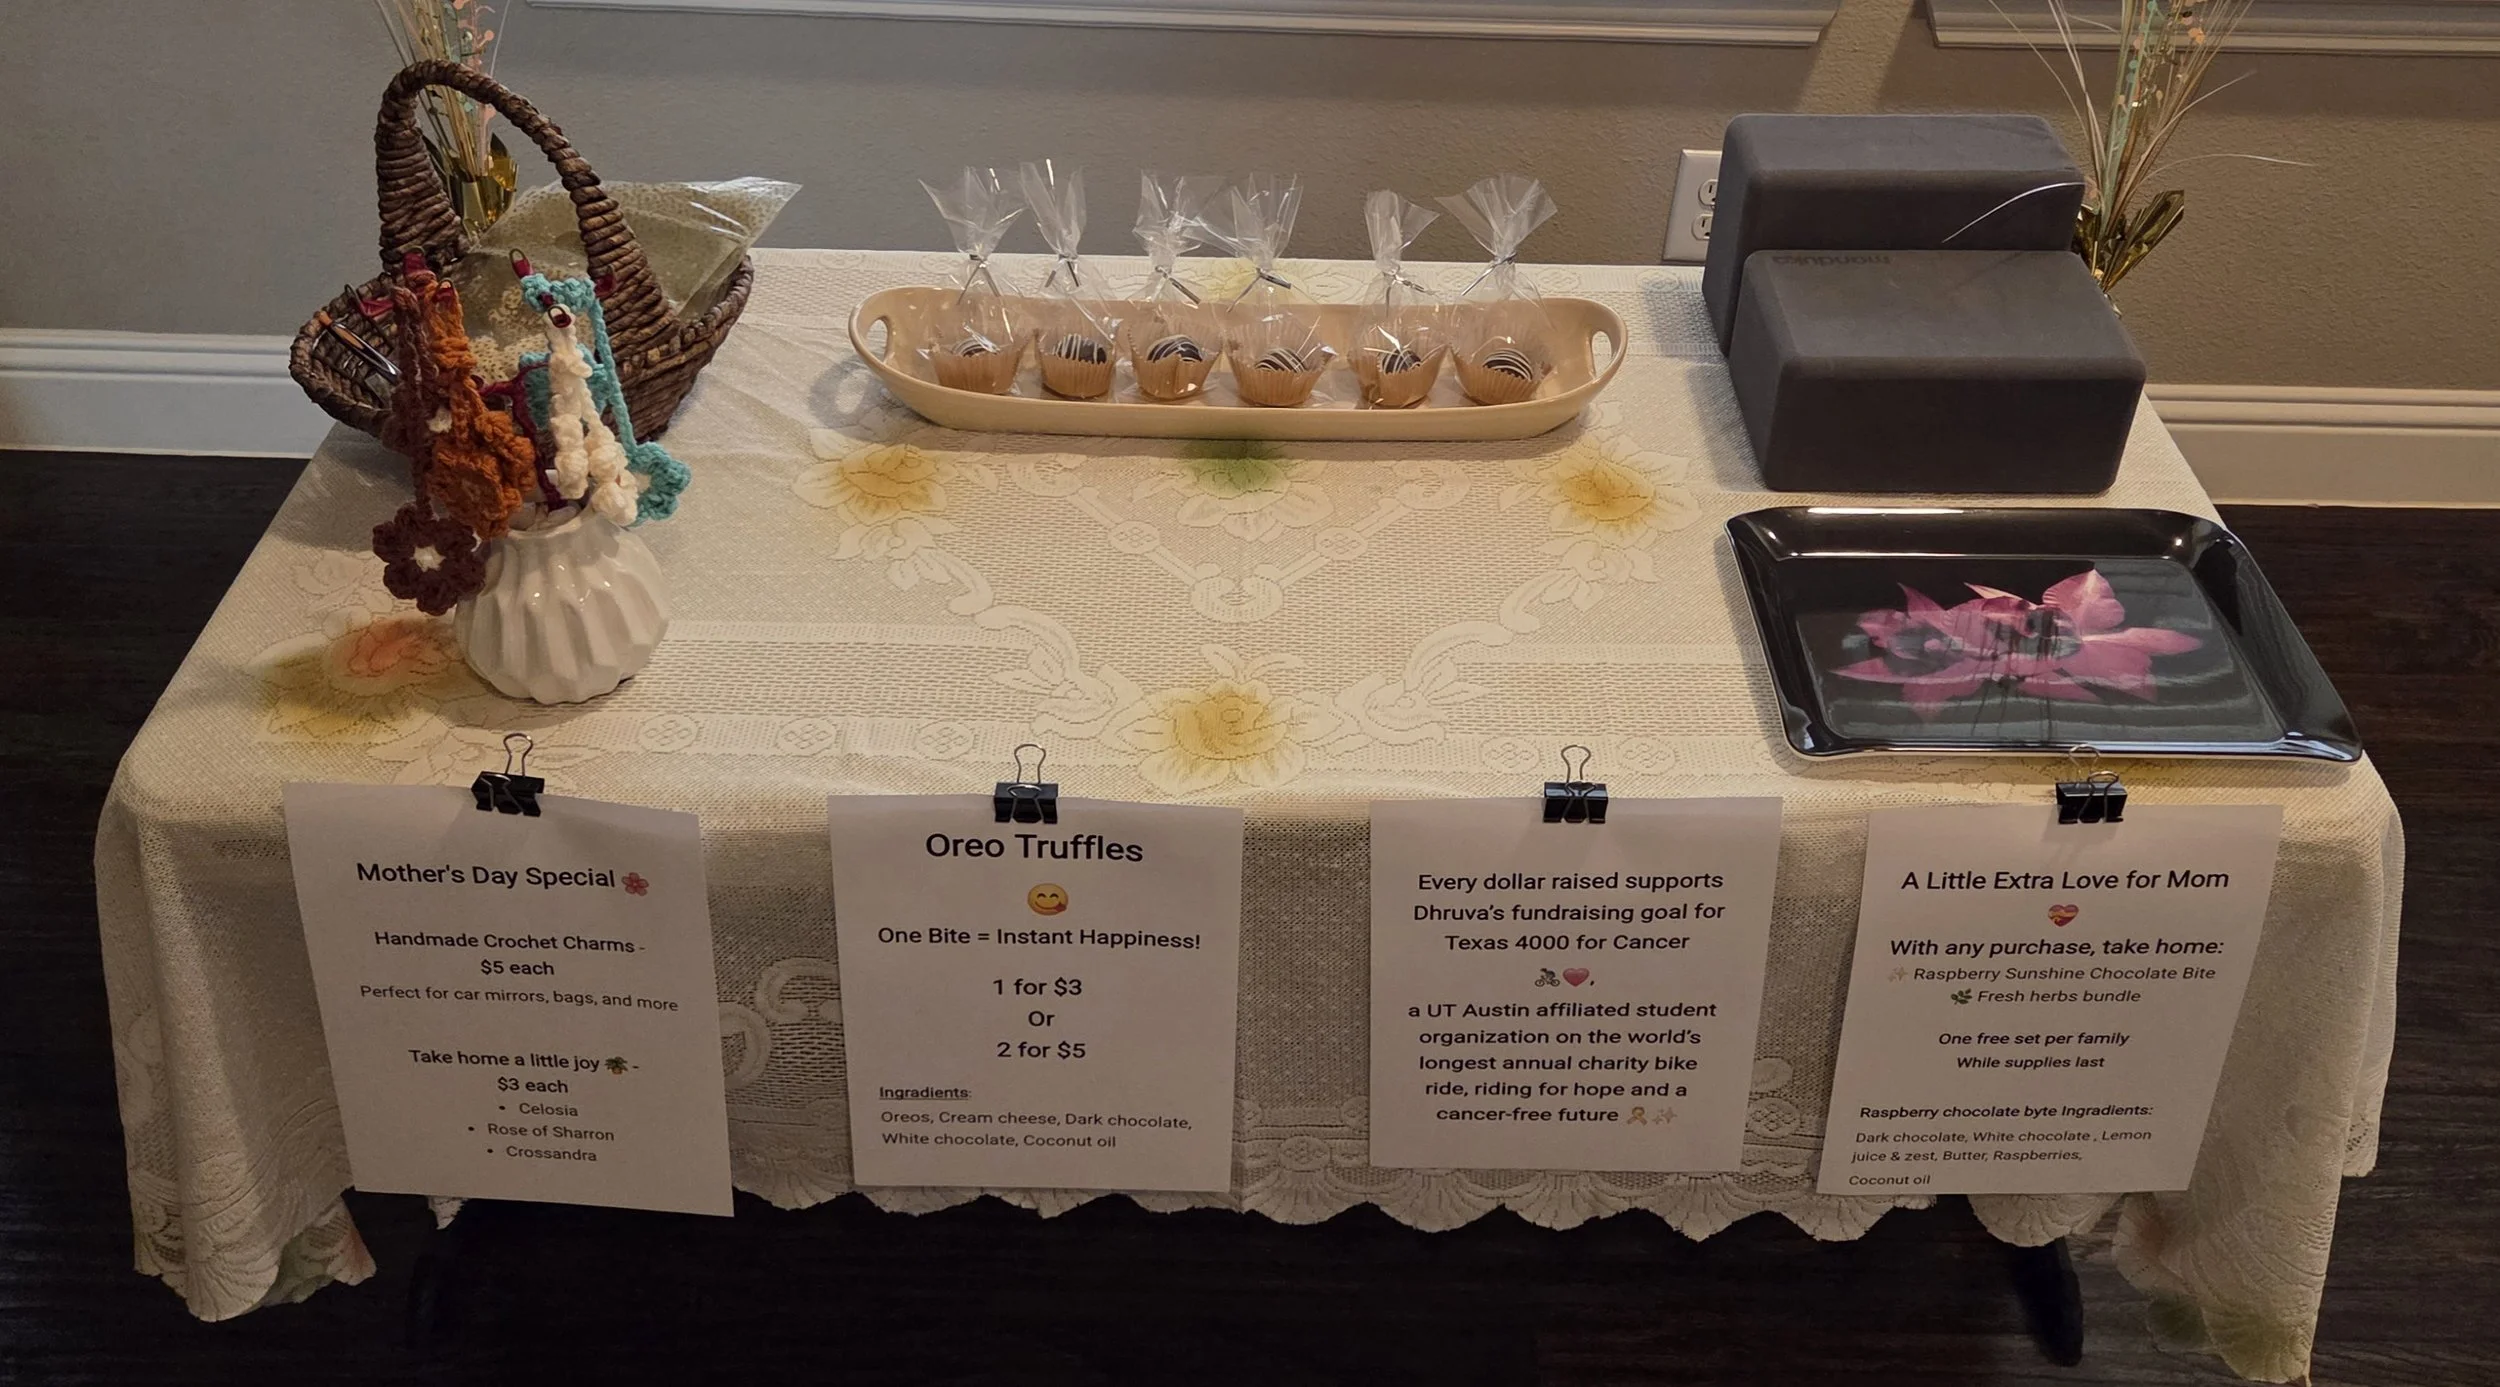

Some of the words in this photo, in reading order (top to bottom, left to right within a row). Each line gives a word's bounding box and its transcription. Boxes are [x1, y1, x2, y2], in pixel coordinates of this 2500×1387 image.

[1771, 255, 1890, 268] manduka
[926, 834, 1004, 857] Oreo
[1015, 834, 1143, 862] Truffles
[357, 863, 465, 883] Mother's
[472, 866, 518, 889] Day
[526, 867, 615, 889] Special
[1419, 875, 1477, 893] Every
[1484, 873, 1546, 889] dollar
[1552, 872, 1618, 889] raised
[1626, 874, 1723, 892] supports
[1901, 872, 1919, 889] A
[1927, 871, 1986, 889] Little
[1994, 872, 2053, 889] Extra
[2062, 872, 2118, 889] Love
[2126, 870, 2161, 888] for
[2167, 870, 2229, 888] Mom
[1512, 904, 1634, 923] fundraising
[1641, 904, 1687, 923] goal
[1695, 903, 1725, 918] for
[375, 932, 478, 947] Handmade
[484, 934, 558, 949] Crochet
[563, 936, 635, 953] Charms
[878, 928, 921, 943] One
[929, 928, 970, 943] Bite
[998, 929, 1072, 944] Instant
[1080, 929, 1199, 949] Happiness!
[1445, 936, 1508, 950] Texas
[1515, 935, 1569, 950] 4000
[1577, 935, 1607, 949] for
[1614, 935, 1690, 949] Cancer
[1891, 940, 1938, 955] With
[1945, 943, 1984, 958] any
[1989, 939, 2095, 958] purchase,
[2103, 939, 2149, 954] take
[2156, 939, 2224, 954] home:
[481, 959, 504, 975] $5
[510, 961, 554, 975] each
[1914, 968, 2000, 982] Raspberry
[2005, 968, 2084, 979] Sunshine
[2090, 968, 2177, 979] Chocolate
[2183, 967, 2215, 979] Bite
[993, 979, 1002, 995] 1
[1014, 978, 1047, 995] for
[1054, 977, 1082, 997] $3
[361, 986, 421, 999] Perfect
[426, 987, 448, 999] for
[454, 991, 480, 1000] car
[485, 990, 549, 1003] mirrors,
[553, 991, 597, 1006] bags,
[602, 995, 632, 1006] and
[637, 999, 678, 1011] more
[1978, 990, 2024, 1002] Fresh
[2030, 990, 2078, 1002] herbs
[2083, 990, 2141, 1001] bundle
[1408, 1007, 1420, 1017] a
[1428, 1004, 1456, 1017] UT
[1463, 1004, 1529, 1017] Austin
[1536, 1003, 1630, 1016] affiliated
[1637, 1003, 1717, 1016] student
[1029, 1011, 1055, 1026] Or
[1420, 1030, 1549, 1046] organization
[1556, 1033, 1581, 1043] on
[1588, 1029, 1621, 1043] the
[1939, 1034, 1972, 1044] One
[1978, 1033, 2010, 1044] free
[2014, 1034, 2040, 1044] set
[2045, 1035, 2074, 1046] per
[2078, 1032, 2130, 1046] family
[997, 1042, 1011, 1057] 2
[1018, 1042, 1051, 1058] for
[1058, 1041, 1085, 1059] $5
[408, 1050, 452, 1064] Take
[457, 1051, 509, 1065] home
[515, 1056, 525, 1066] a
[531, 1053, 569, 1068] little
[574, 1056, 599, 1072] joy
[1420, 1056, 1496, 1072] longest
[1503, 1056, 1571, 1069] annual
[1578, 1056, 1649, 1073] charity
[1655, 1056, 1697, 1070] bike
[1958, 1057, 2000, 1068] While
[2005, 1057, 2071, 1070] supplies
[2075, 1057, 2104, 1067] last
[498, 1077, 519, 1091] $3
[526, 1080, 568, 1093] each
[1426, 1082, 1468, 1097] ride,
[1475, 1082, 1531, 1099] riding
[1539, 1082, 1568, 1096] for
[1574, 1082, 1624, 1099] hope
[1631, 1083, 1669, 1096] and
[1675, 1086, 1687, 1096] a
[519, 1103, 578, 1116] Celosia
[1437, 1107, 1552, 1121] cancer-free
[1558, 1108, 1618, 1121] future
[1860, 1107, 1939, 1120] Raspberry
[1943, 1106, 2020, 1117] chocolate
[2024, 1106, 2057, 1119] byte
[881, 1112, 933, 1124] Oreos,
[939, 1112, 992, 1123] Cream
[998, 1112, 1060, 1126] cheese,
[1066, 1114, 1102, 1125] Dark
[1108, 1115, 1191, 1130] chocolate,
[488, 1123, 527, 1136] Rose
[532, 1125, 547, 1136] of
[553, 1126, 614, 1141] Sharron
[882, 1133, 929, 1144] White
[934, 1134, 1018, 1147] chocolate,
[1024, 1135, 1092, 1146] Coconut
[1097, 1136, 1115, 1147] oil
[1856, 1133, 1889, 1142] Dark
[1893, 1132, 1968, 1143] chocolate,
[1974, 1132, 2014, 1141] White
[2018, 1131, 2090, 1141] chocolate
[2102, 1131, 2151, 1140] Lemon
[506, 1146, 596, 1161] Crossandra
[1851, 1152, 1886, 1163] juice
[1891, 1152, 1900, 1161] &
[1905, 1152, 1937, 1161] zest,
[1943, 1151, 1987, 1161] Butter,
[1994, 1150, 2082, 1162] Raspberries,
[1849, 1176, 1909, 1185] Coconut
[1913, 1175, 1930, 1184] oil
